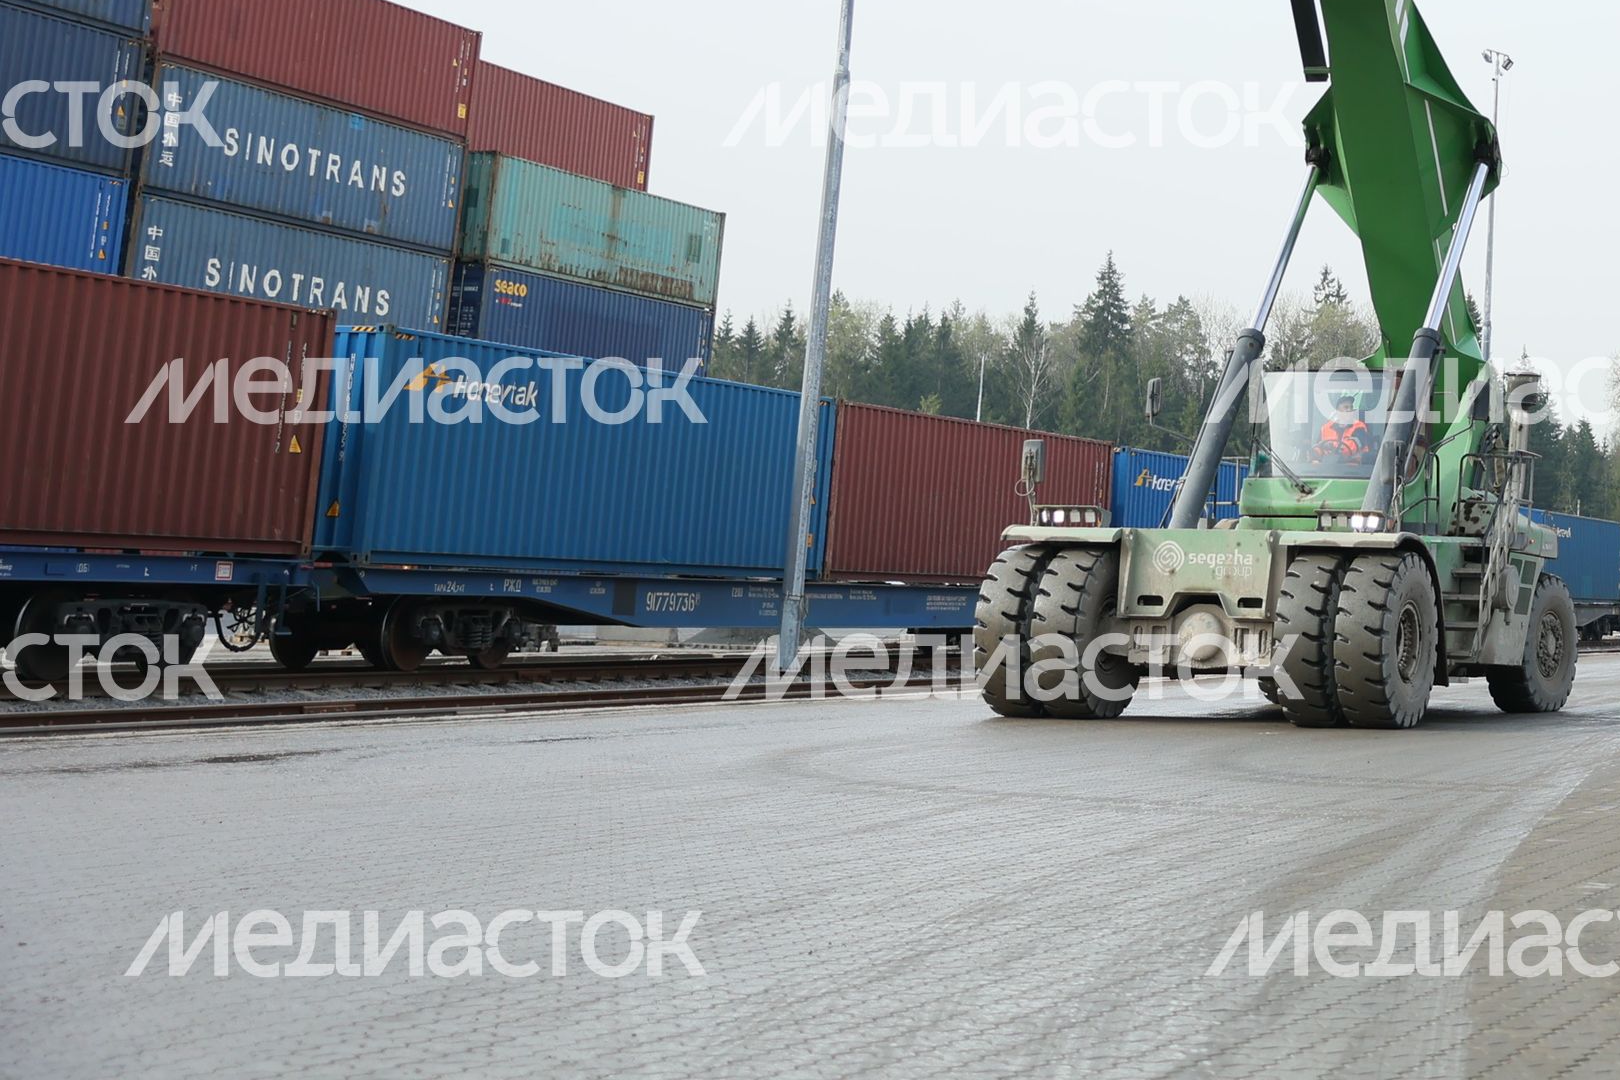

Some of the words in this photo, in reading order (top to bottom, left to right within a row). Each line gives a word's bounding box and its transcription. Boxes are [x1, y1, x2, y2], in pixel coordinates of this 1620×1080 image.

[223, 127, 406, 197] SINOTRANS
[205, 257, 390, 316] SINOTRANS
[494, 279, 528, 297] seaco
[453, 374, 538, 408] Honeytak
[1188, 549, 1253, 569] segezha
